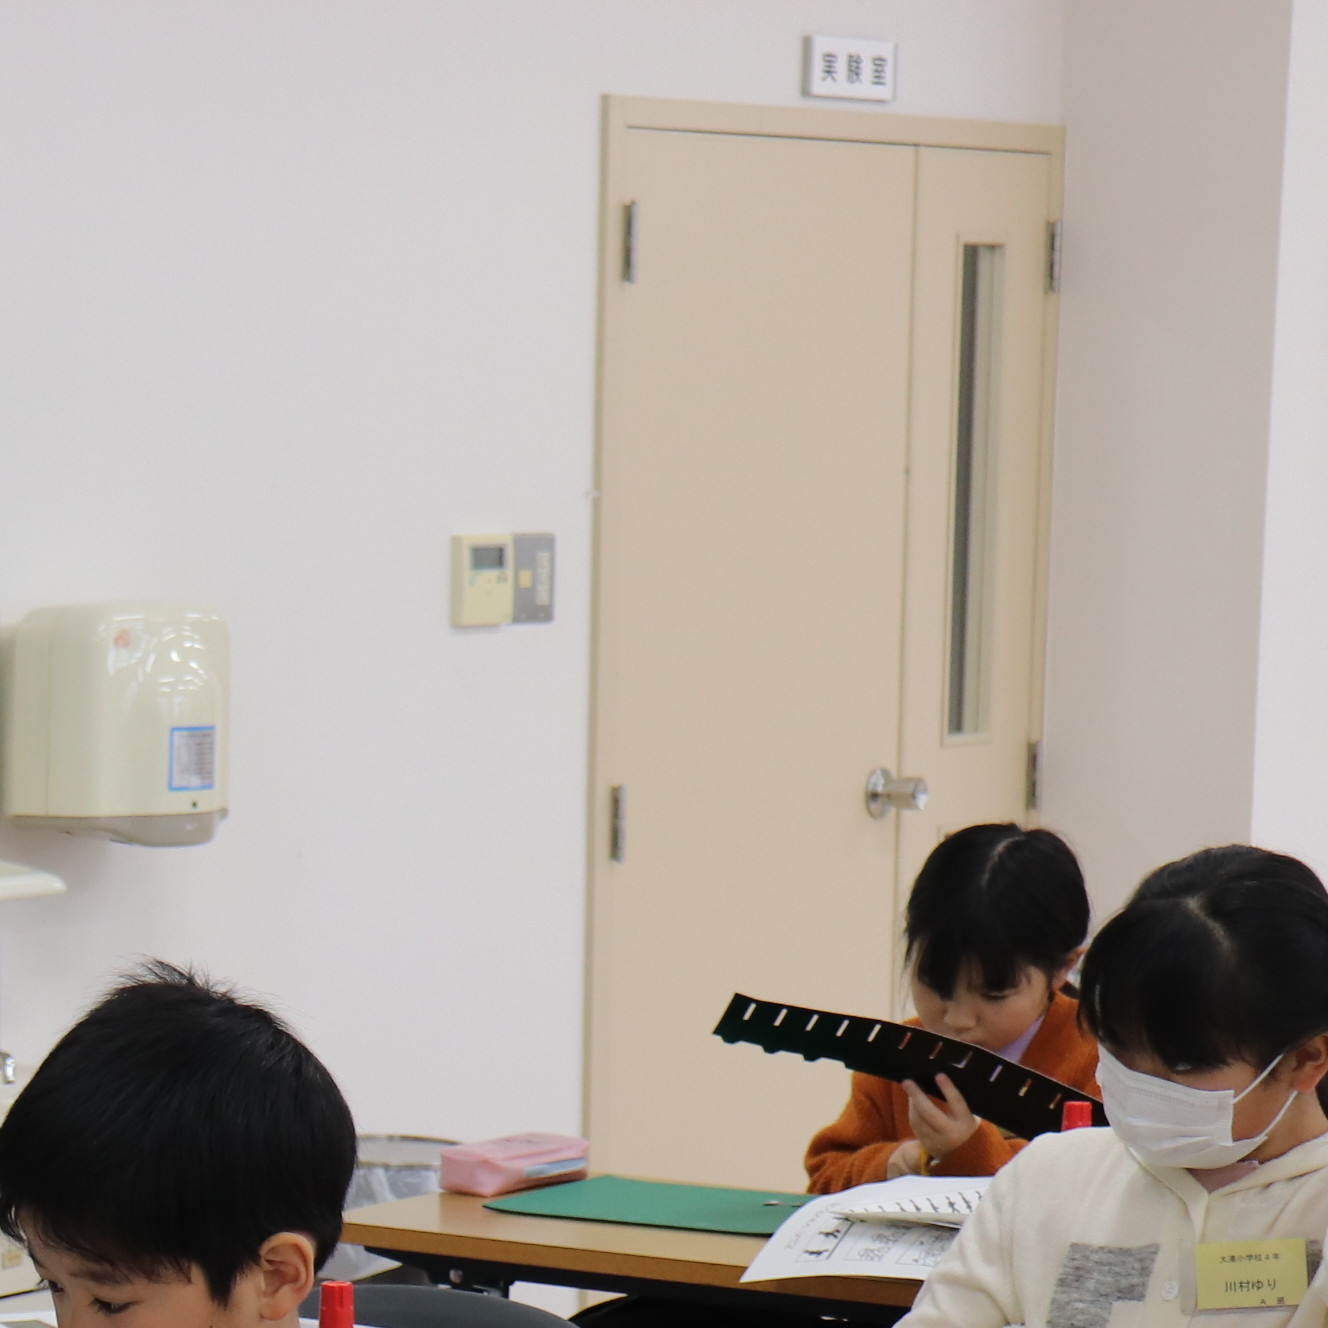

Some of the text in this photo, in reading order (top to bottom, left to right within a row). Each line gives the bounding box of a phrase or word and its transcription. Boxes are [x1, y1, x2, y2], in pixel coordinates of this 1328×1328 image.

[821, 52, 888, 87] 実験室
[1224, 1278, 1277, 1293] 川村ゆり
